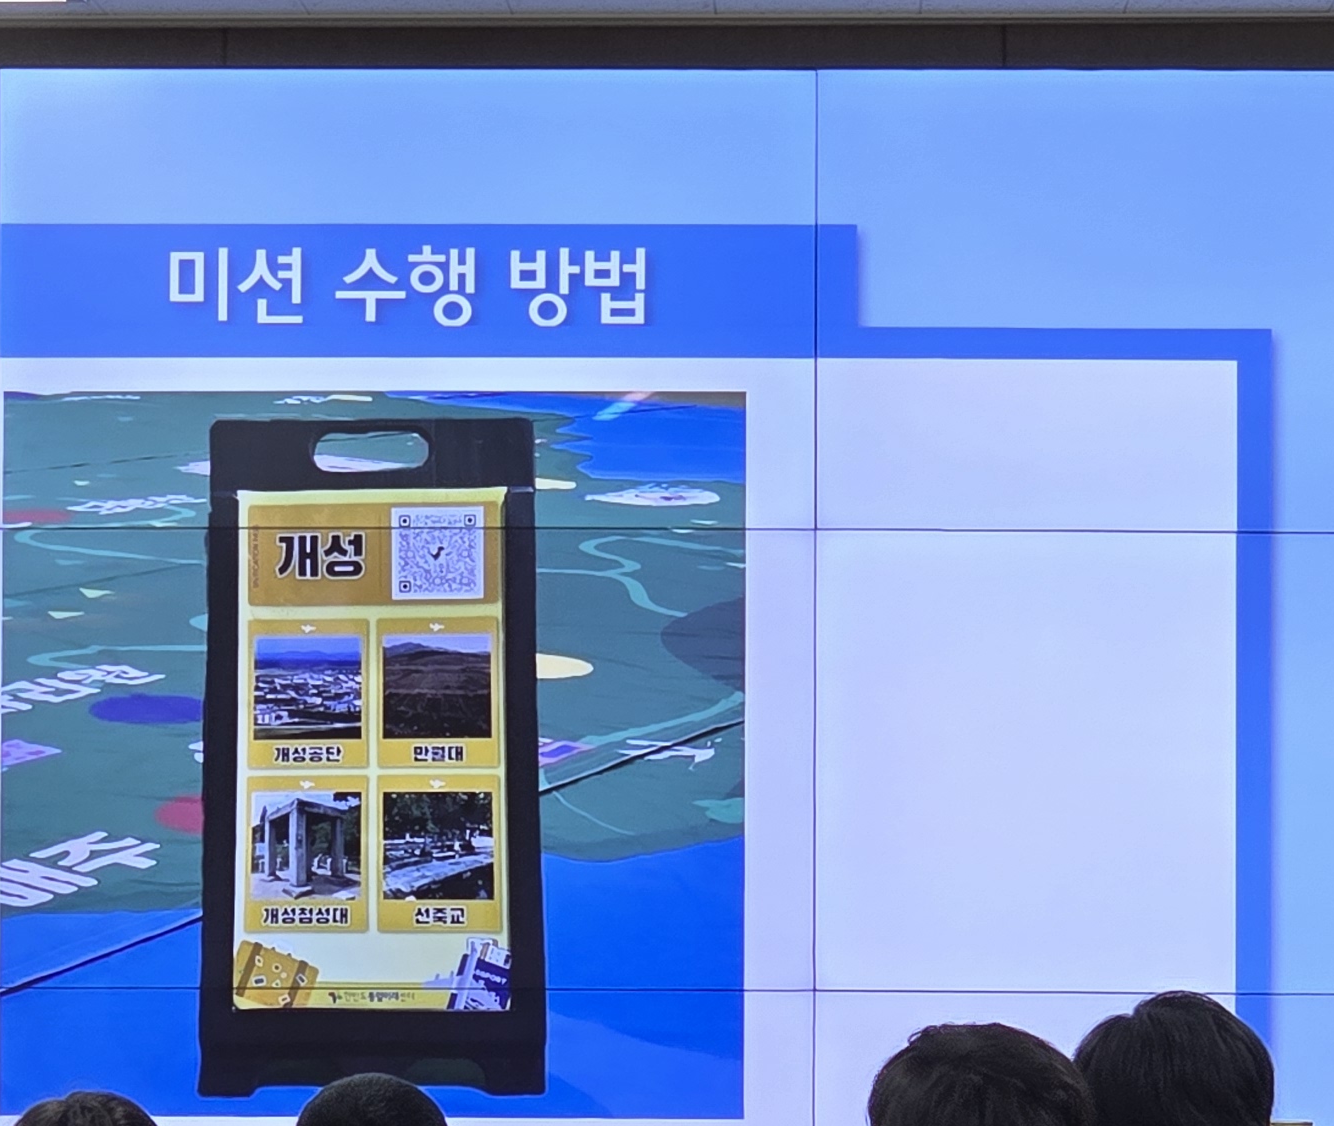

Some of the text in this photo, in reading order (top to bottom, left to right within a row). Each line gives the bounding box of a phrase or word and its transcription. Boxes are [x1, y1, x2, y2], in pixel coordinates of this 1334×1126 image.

[169, 245, 646, 327] 미션 수행 방법
[276, 531, 365, 579] 개성
[273, 745, 343, 764] 개성공단
[262, 907, 349, 925] 개성첨성대
[414, 907, 465, 925] 선죽교
